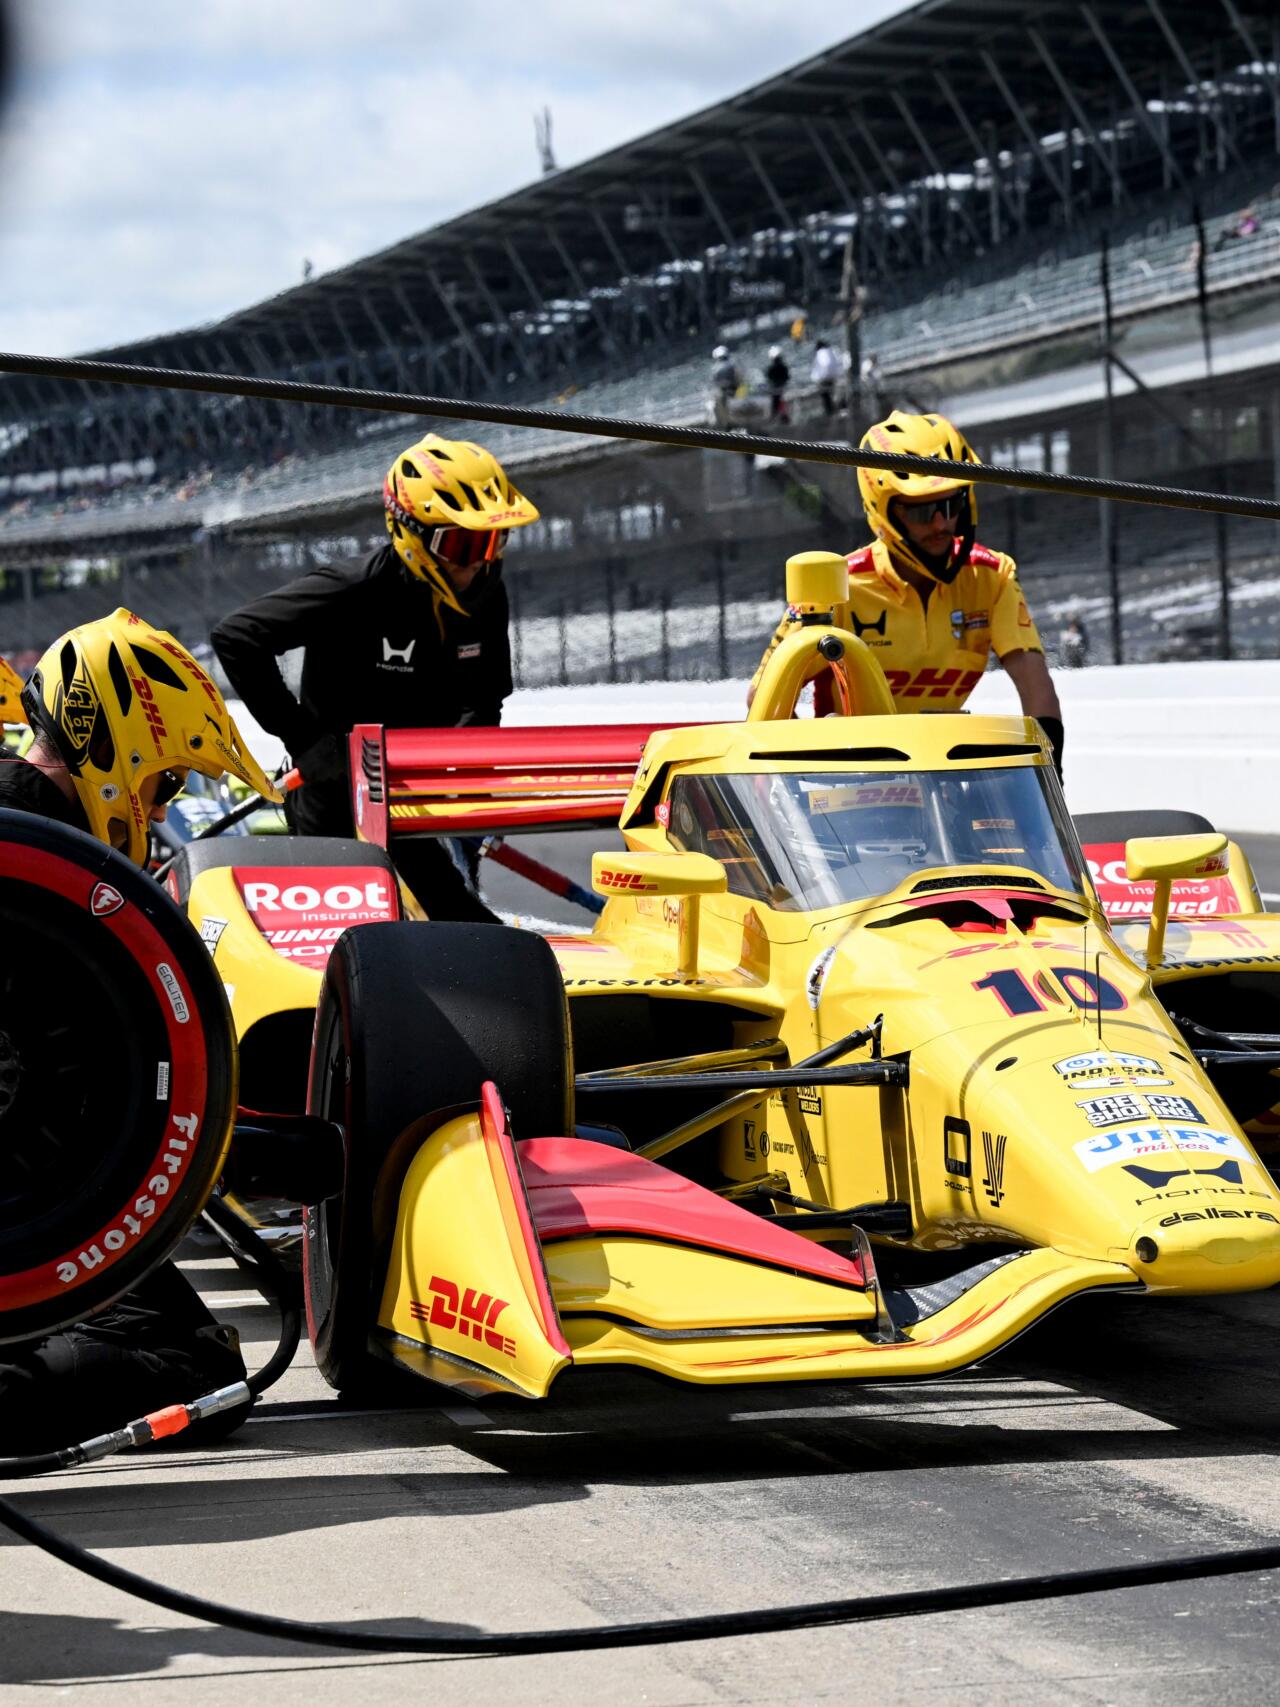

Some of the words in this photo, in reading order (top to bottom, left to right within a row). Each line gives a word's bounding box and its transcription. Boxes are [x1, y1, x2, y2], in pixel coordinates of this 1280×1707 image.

[376, 662, 414, 672] Honda
[132, 677, 169, 746] DHL
[855, 787, 922, 804] DHL
[129, 792, 143, 831] DHL
[601, 870, 647, 889] DHL
[243, 882, 389, 912] Root
[1102, 897, 1218, 914] SUNCO
[970, 967, 1128, 1018] 10
[56, 1112, 199, 1284] Firestone
[1135, 1188, 1273, 1206] Honda
[1159, 1207, 1280, 1228] dallara
[429, 1276, 511, 1352] DHL
